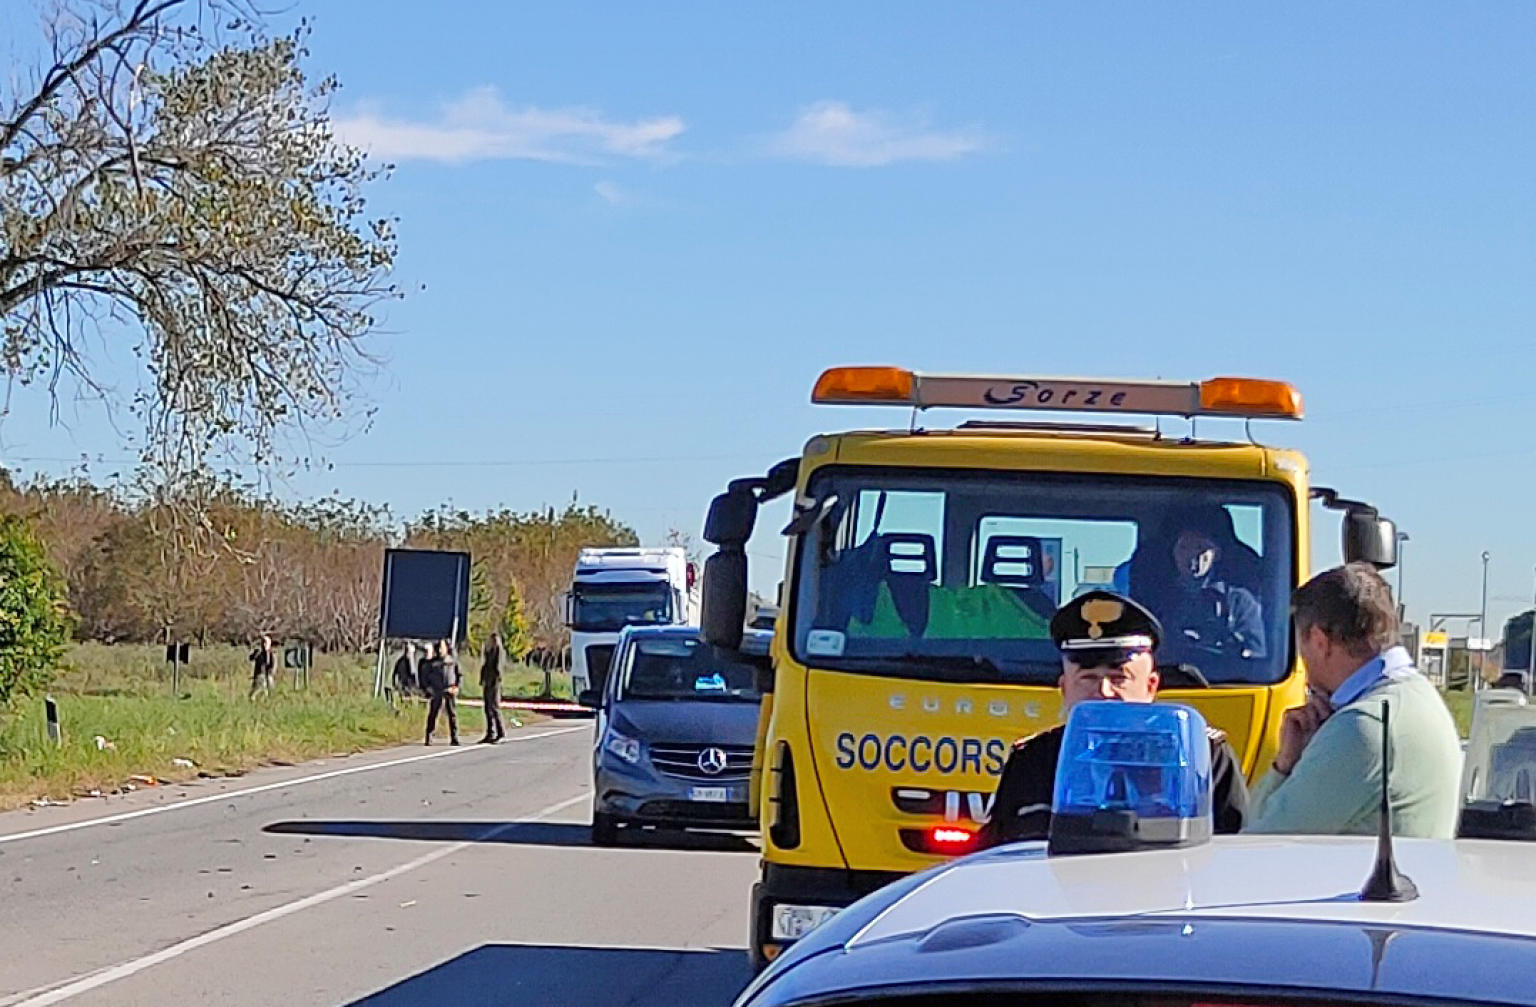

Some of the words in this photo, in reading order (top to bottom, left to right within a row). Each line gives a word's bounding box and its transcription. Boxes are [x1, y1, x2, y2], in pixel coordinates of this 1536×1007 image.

[888, 694, 1068, 719] EUROC
[836, 733, 1005, 775] SOCCORS
[944, 790, 996, 824] IV
